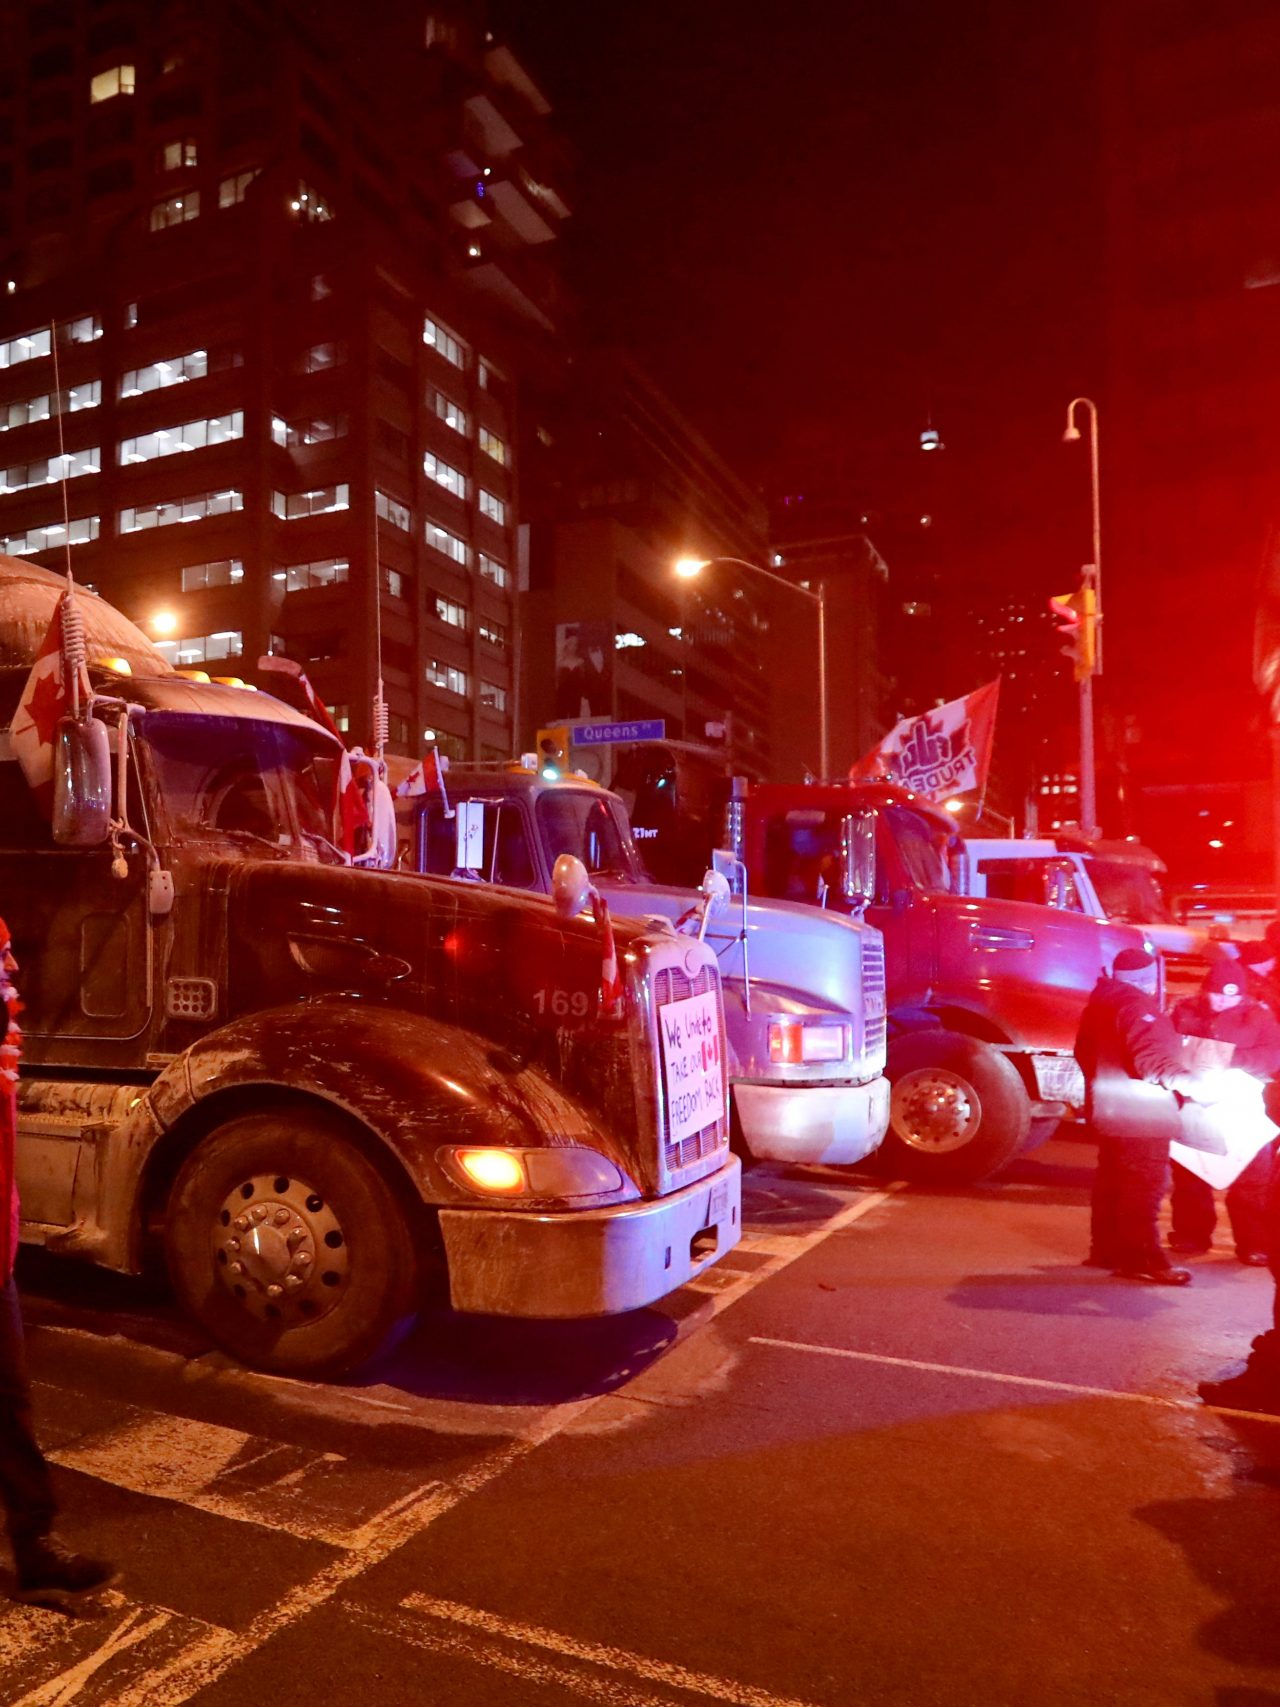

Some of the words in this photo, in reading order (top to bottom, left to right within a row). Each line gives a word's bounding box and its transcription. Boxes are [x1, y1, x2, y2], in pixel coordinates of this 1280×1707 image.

[584, 726, 638, 740] Queens
[533, 990, 589, 1016] 169
[665, 1018, 681, 1048] We
[671, 1056, 688, 1083] TAKE
[671, 1087, 702, 1128] FREEDOM
[705, 1076, 720, 1108] BACK
